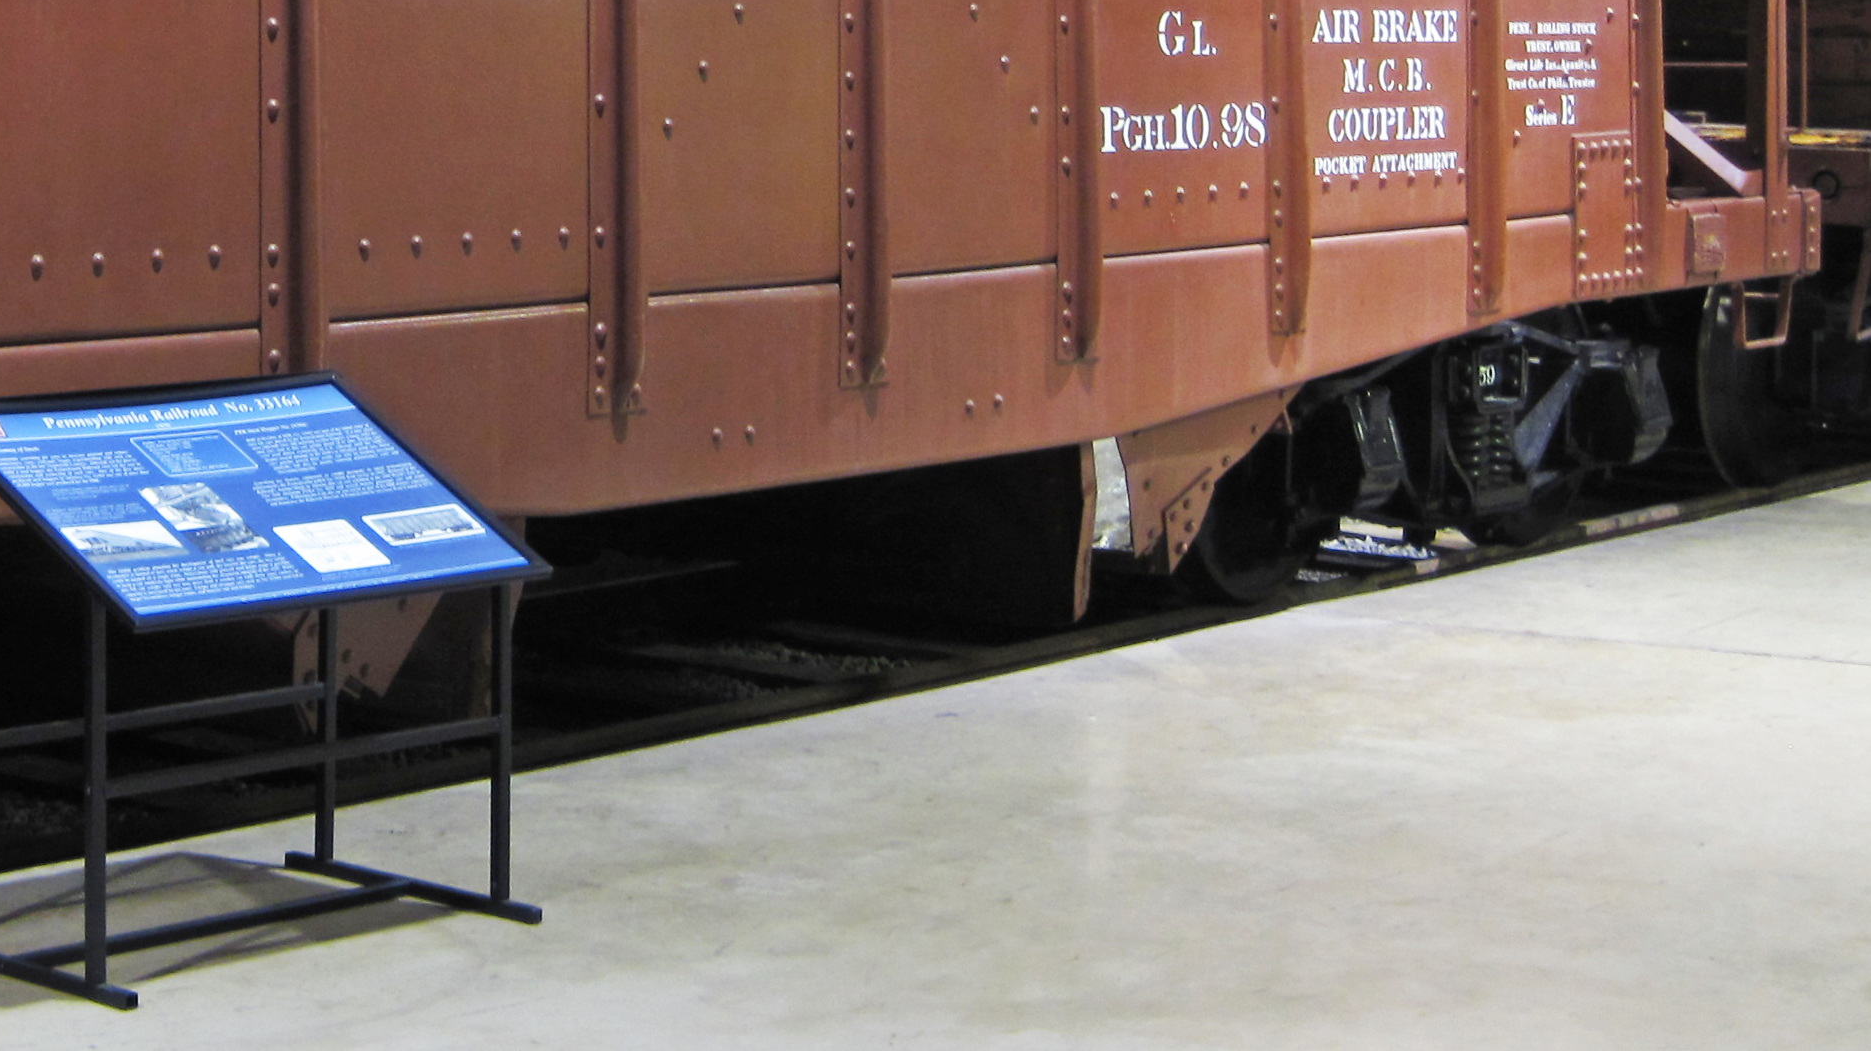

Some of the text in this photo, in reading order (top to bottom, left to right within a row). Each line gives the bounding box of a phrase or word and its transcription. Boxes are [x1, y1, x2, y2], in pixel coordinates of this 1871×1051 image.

[1311, 8, 1459, 44] AIR BRAKE
[1572, 21, 1598, 36] STOCK
[1342, 57, 1433, 93] M.C.B.
[1327, 105, 1446, 143] COUPLER
[1524, 94, 1576, 127] Series E
[1313, 150, 1458, 176] POCKET ATTACHMENT
[42, 393, 302, 430] Pennsylvania Railroad No. 33164
